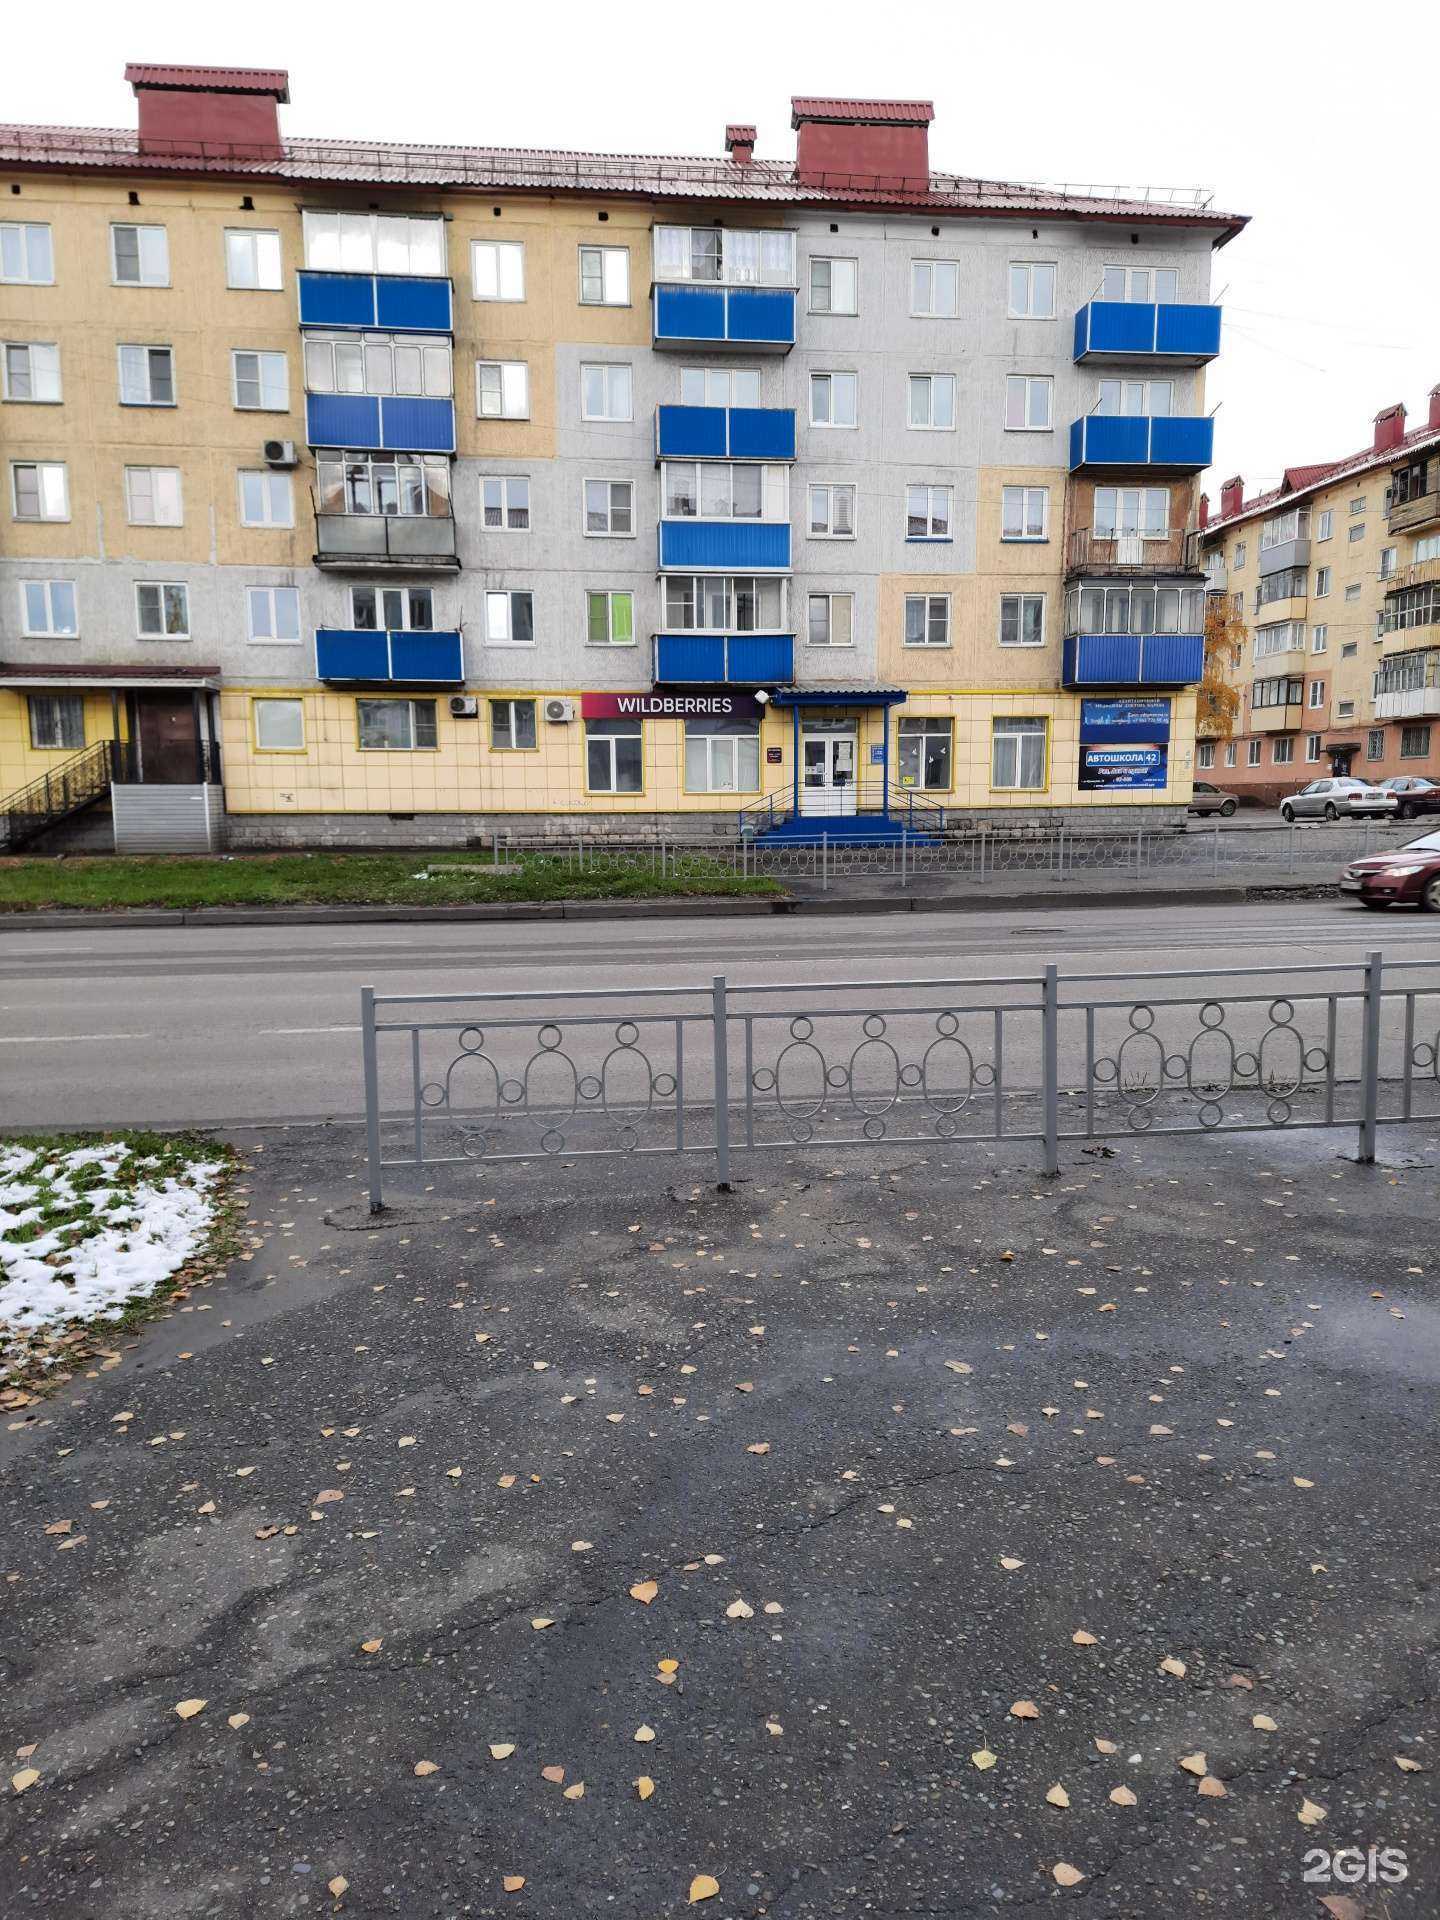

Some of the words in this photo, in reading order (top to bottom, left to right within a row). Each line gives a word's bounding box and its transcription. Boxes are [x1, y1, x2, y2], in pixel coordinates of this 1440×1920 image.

[617, 697, 733, 714] WILDBERRIES
[1087, 754, 1144, 763] АВТОШКОЛА
[1145, 753, 1157, 762] 42
